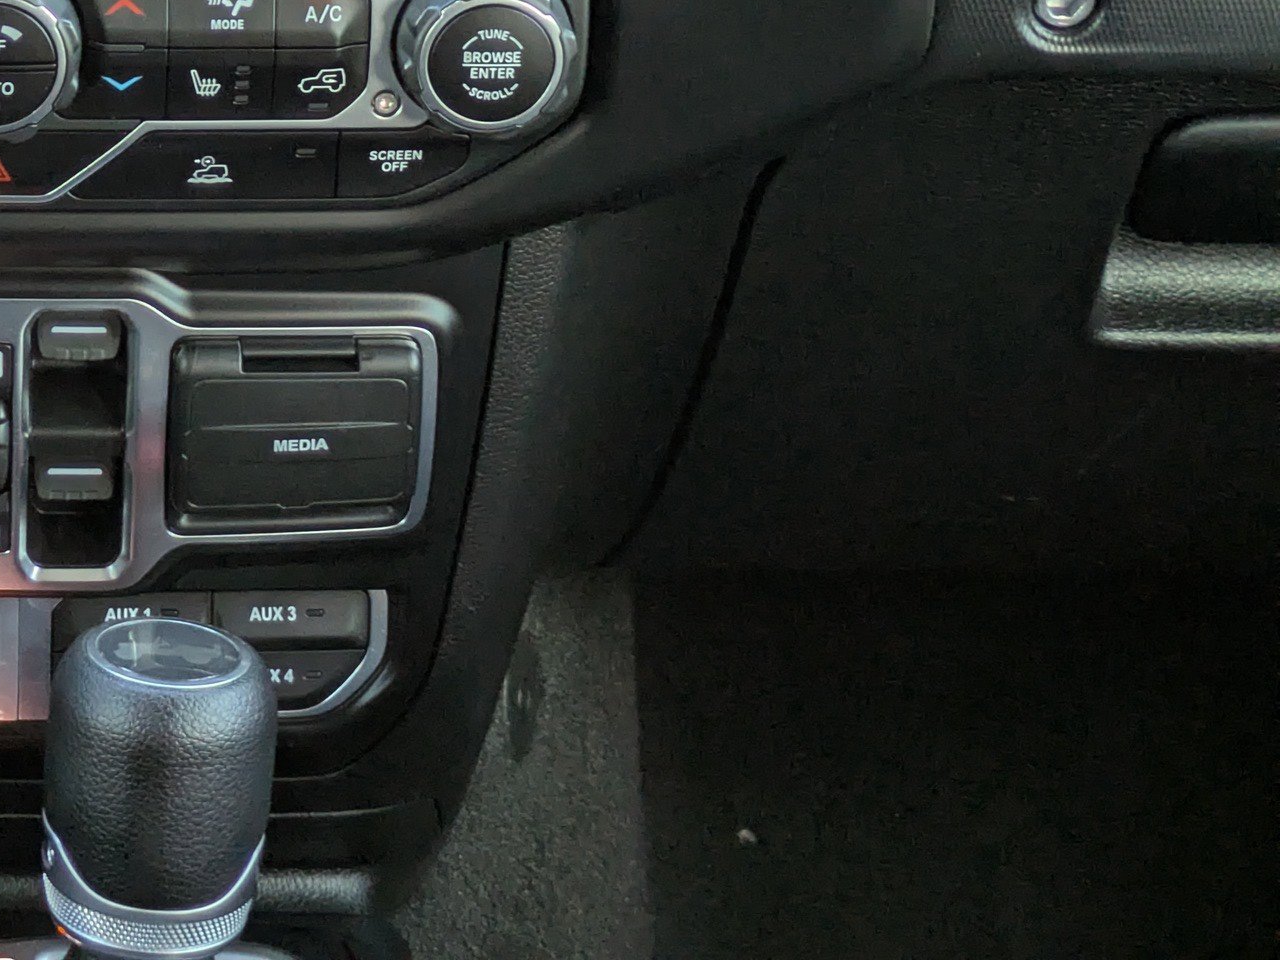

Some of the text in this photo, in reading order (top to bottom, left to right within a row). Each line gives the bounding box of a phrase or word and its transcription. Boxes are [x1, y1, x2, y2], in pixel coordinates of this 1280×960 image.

[305, 5, 342, 24] A/C
[210, 19, 245, 30] MODE
[477, 29, 511, 42] TUNE
[463, 50, 521, 64] BROWSE
[469, 67, 515, 80] ENTER
[468, 86, 515, 101] SCROLL
[369, 149, 423, 161] SCREEN
[381, 161, 408, 172] OFF
[273, 438, 329, 453] MEDIA
[249, 606, 297, 622] AUX 3
[283, 668, 294, 683] 4
